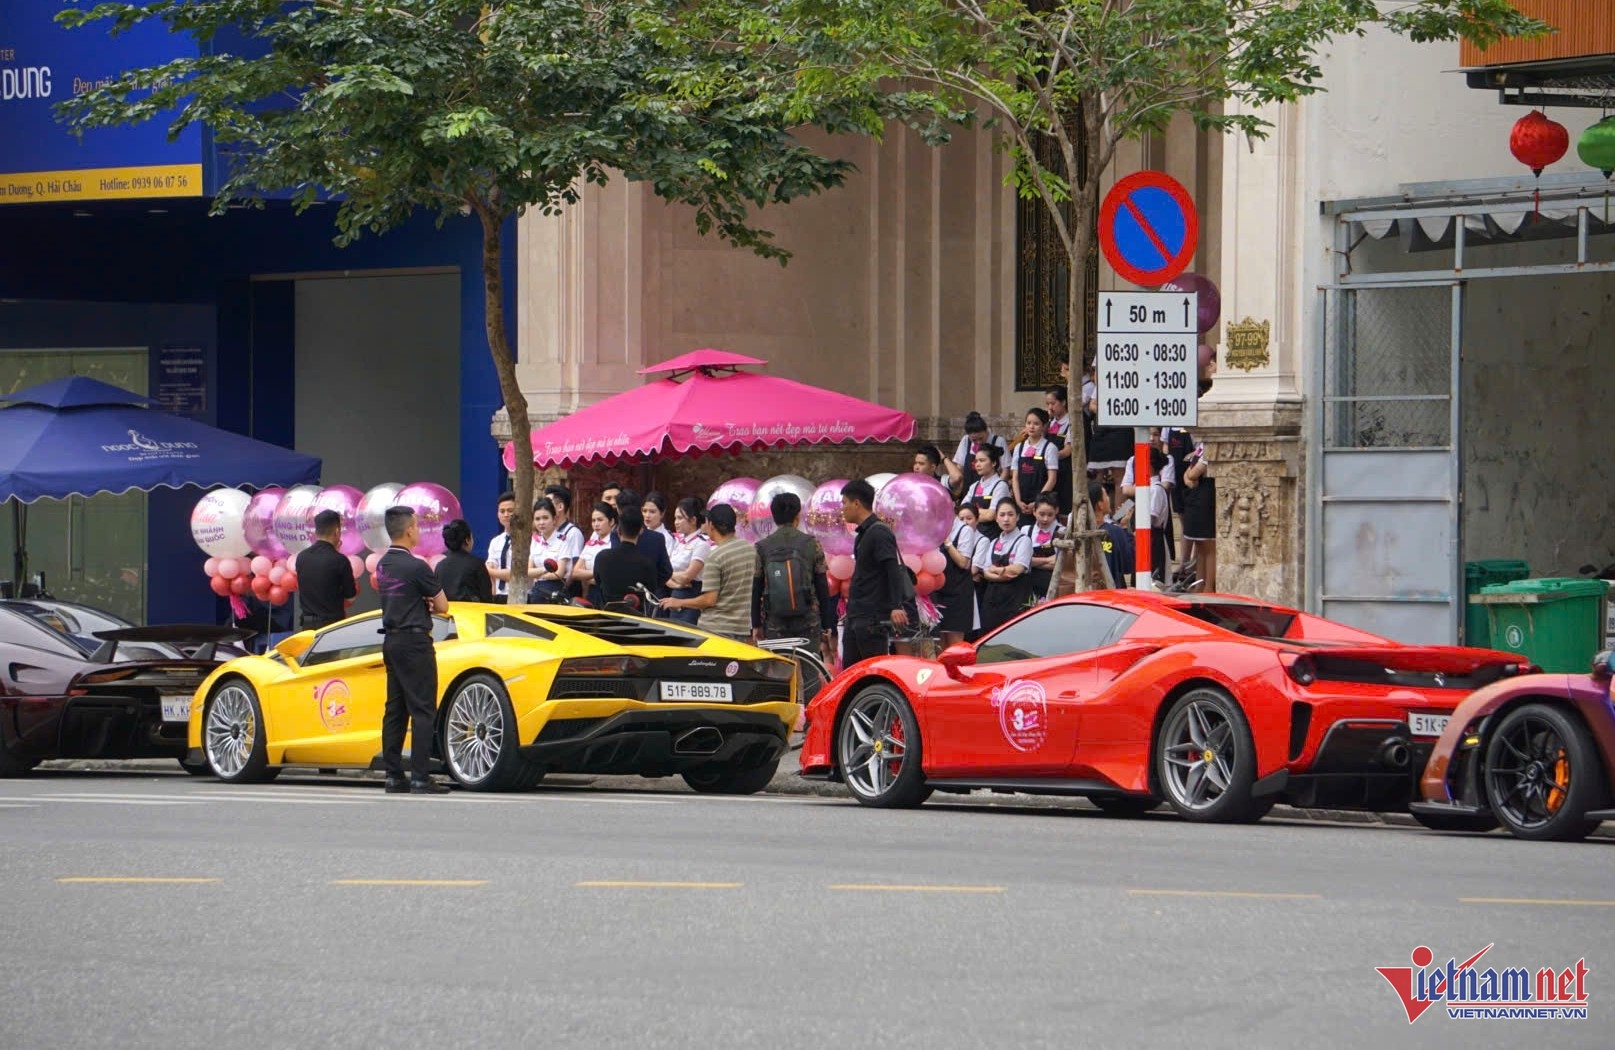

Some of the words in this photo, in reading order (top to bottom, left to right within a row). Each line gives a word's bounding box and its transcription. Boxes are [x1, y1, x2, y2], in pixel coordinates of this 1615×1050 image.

[3, 66, 52, 100] DUNG
[99, 178, 130, 191] Hotline:
[131, 177, 152, 189] 0939
[153, 177, 163, 188] 06
[165, 176, 175, 188] 07
[177, 175, 188, 187] 56
[1129, 305, 1147, 323] 50
[1152, 309, 1166, 323] m
[1105, 344, 1138, 362] 06:30
[1154, 344, 1186, 362] 08:30
[1105, 372, 1138, 389] 11:00
[1154, 372, 1186, 389] 13:00
[1105, 399, 1138, 416] 16:00
[1154, 399, 1186, 416] 19:00
